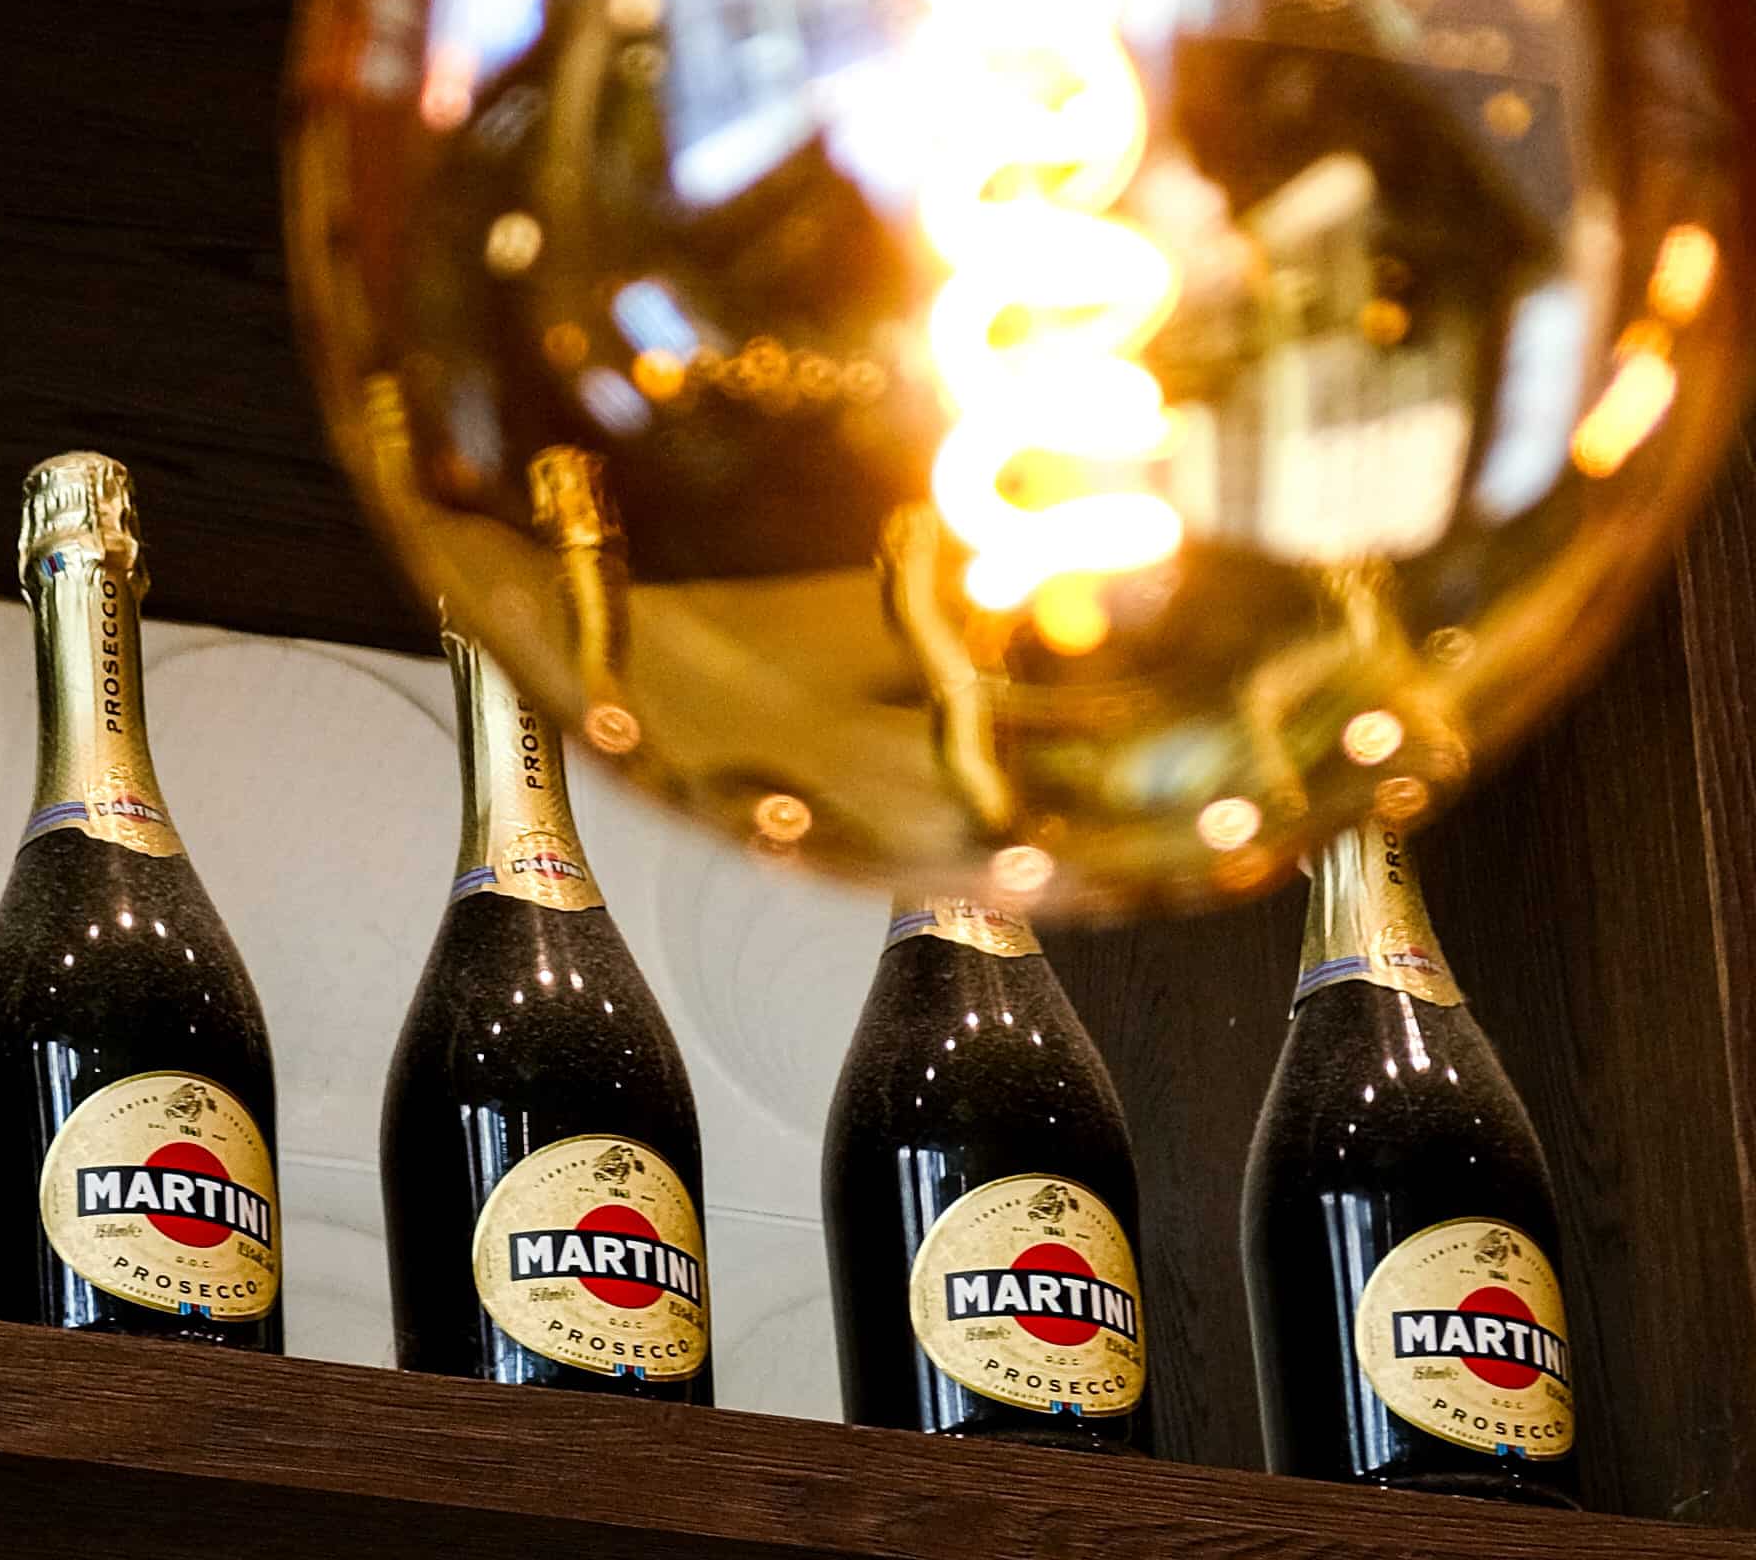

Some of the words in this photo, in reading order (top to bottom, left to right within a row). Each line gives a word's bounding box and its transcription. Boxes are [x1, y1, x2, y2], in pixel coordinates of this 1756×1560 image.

[103, 581, 122, 734] PROSECCO
[518, 697, 543, 789] PROSE
[84, 1171, 268, 1240] MARTINI
[113, 1257, 257, 1299] PROSECCO
[516, 1235, 698, 1299] MARTINI
[952, 1275, 1134, 1335] MARTINI
[548, 1320, 689, 1358] PROSECCO
[1400, 1316, 1568, 1382] MARTINI
[984, 1359, 1125, 1394] PROSECCO
[1433, 1399, 1564, 1439] PROSECCO
